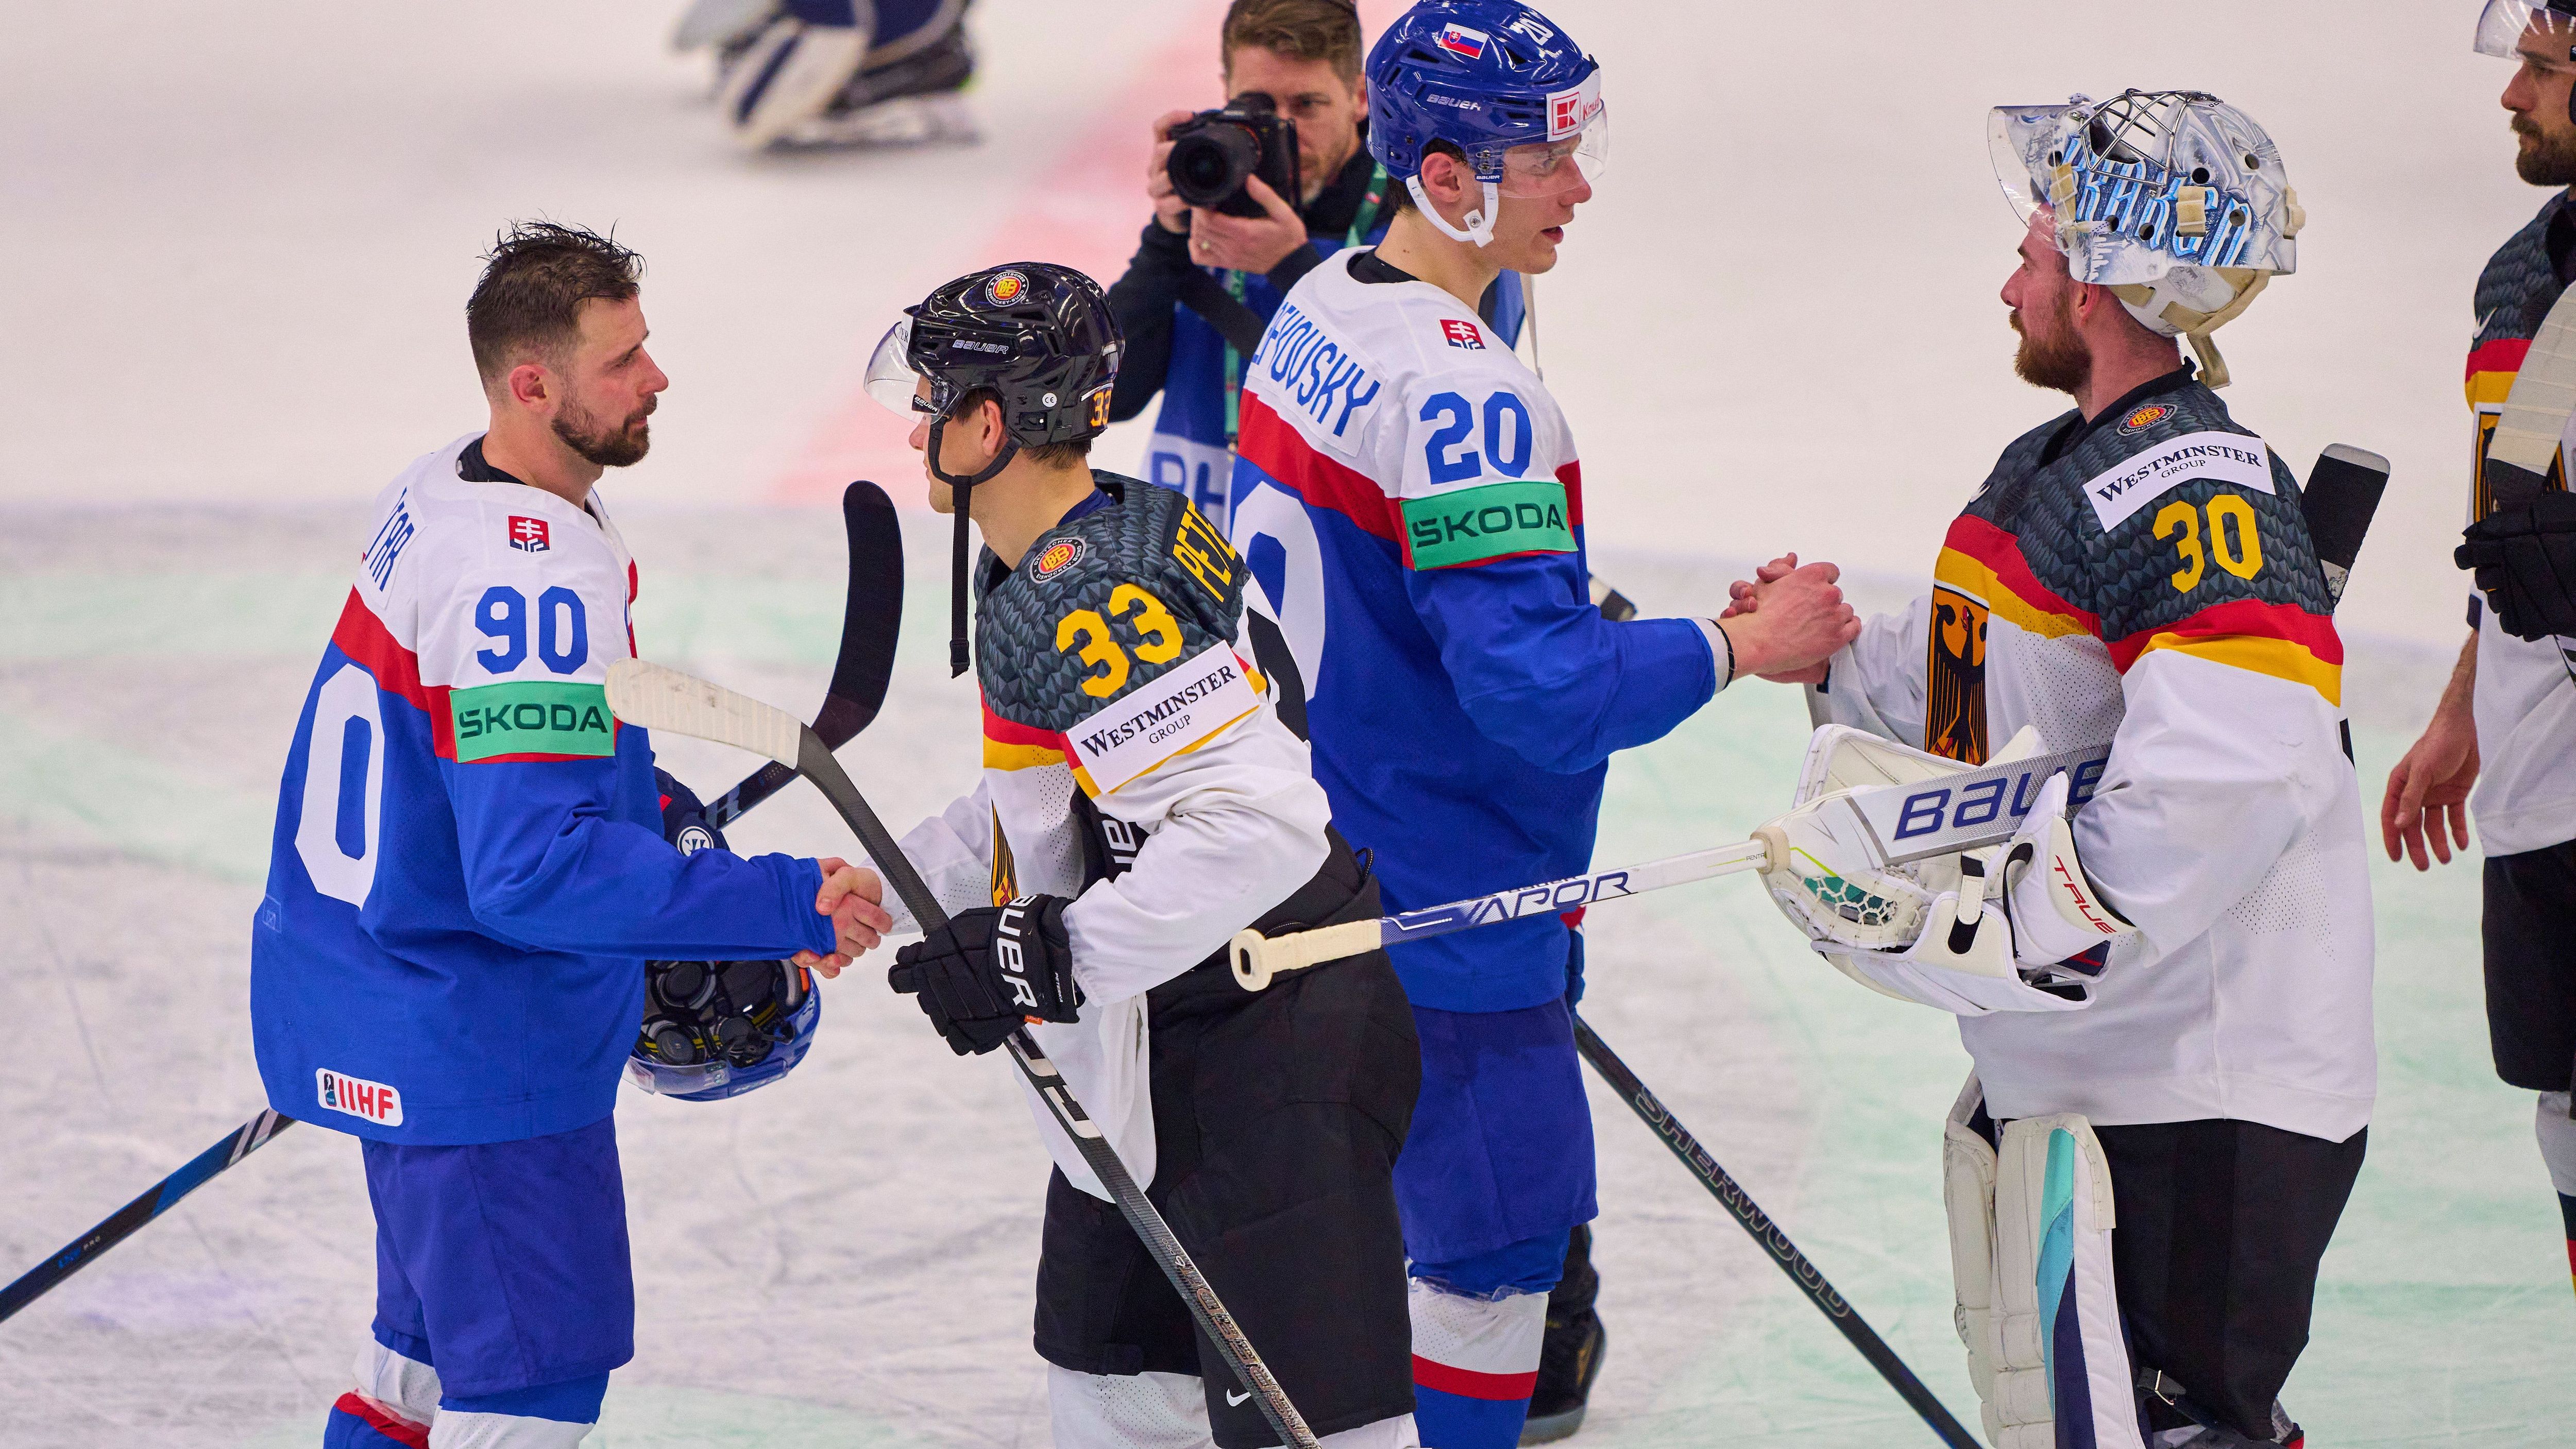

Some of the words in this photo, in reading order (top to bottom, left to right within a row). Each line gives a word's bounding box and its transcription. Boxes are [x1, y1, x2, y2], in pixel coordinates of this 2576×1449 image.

[1427, 94, 1482, 111] BAUER
[995, 272, 1026, 283] DEUTSCHER
[953, 339, 1009, 354] BAUER
[914, 396, 939, 412] BAUER
[1420, 391, 1532, 485] 20
[2097, 445, 2262, 502] WESTMINSTER
[2162, 459, 2207, 479] GROUP
[2153, 495, 2263, 593] 30
[475, 586, 588, 675] 90
[1056, 583, 1183, 698] 33
[1080, 665, 1236, 758] WESTMINSTER
[1148, 714, 1191, 745] GROUP
[2054, 854, 2117, 934] TRUE
[339, 1078, 394, 1119] IIHF
[1633, 1083, 1852, 1318] SHERWOOD
[1161, 1236, 1176, 1256] PRO
